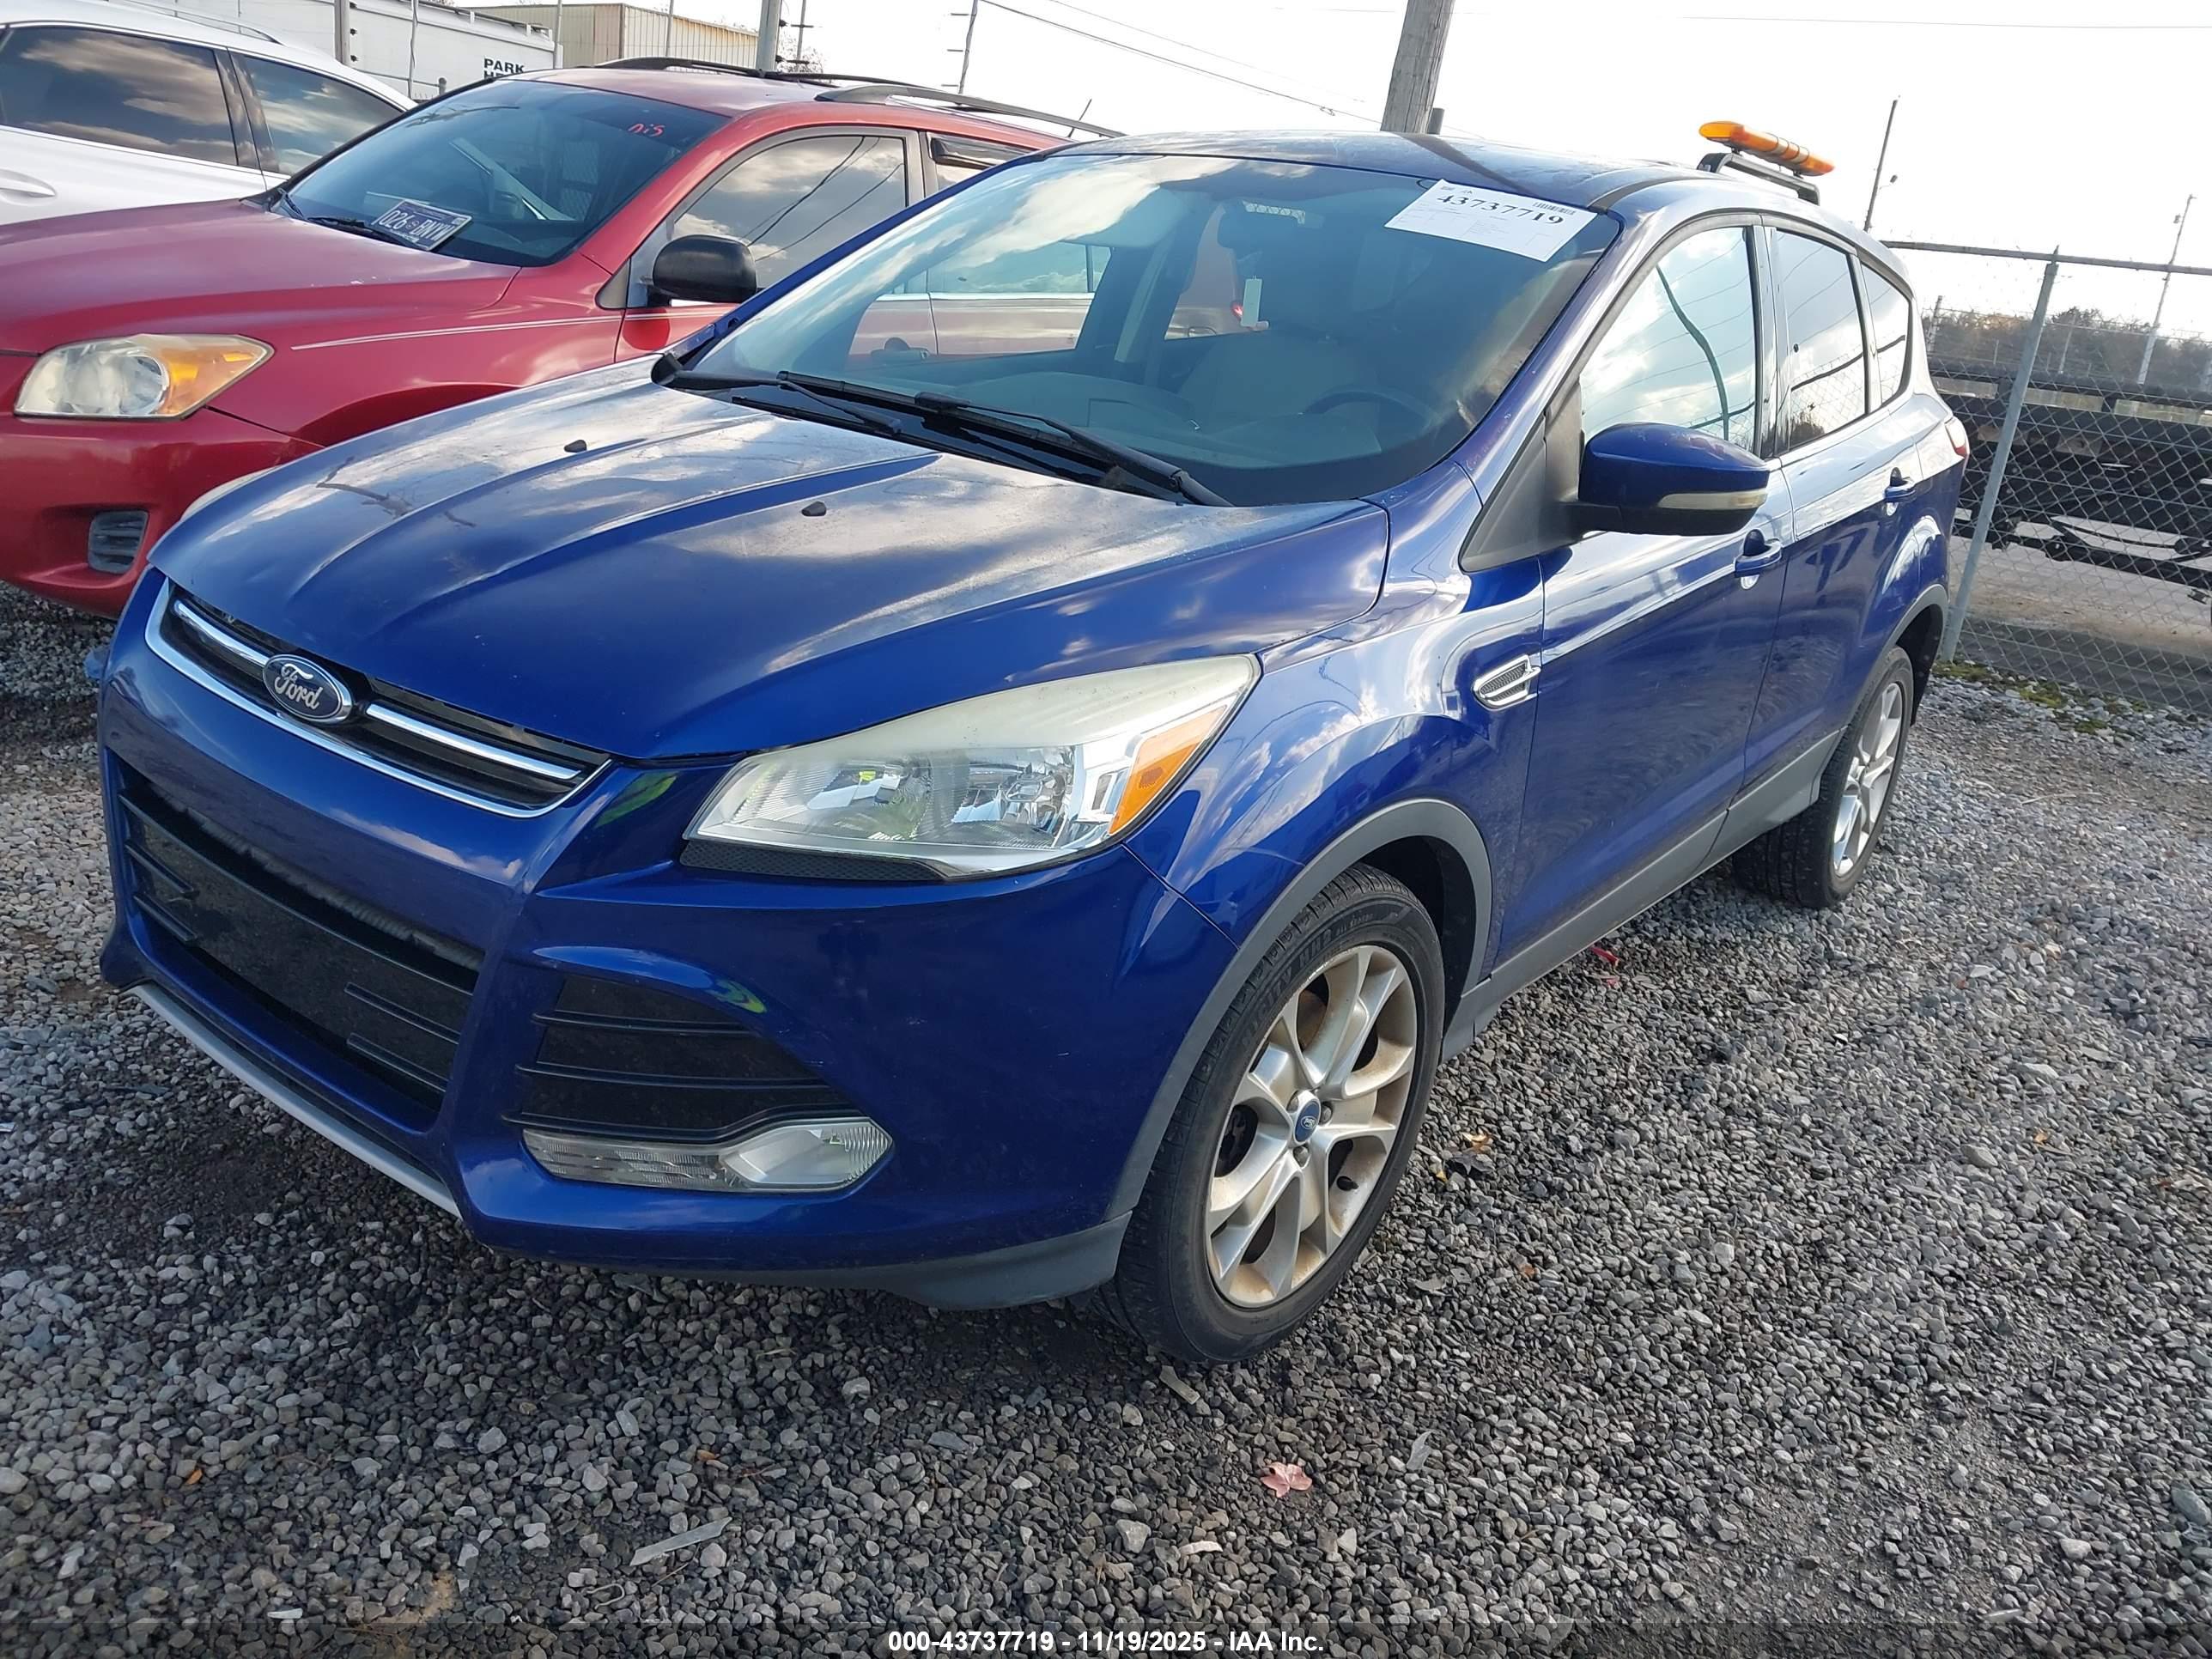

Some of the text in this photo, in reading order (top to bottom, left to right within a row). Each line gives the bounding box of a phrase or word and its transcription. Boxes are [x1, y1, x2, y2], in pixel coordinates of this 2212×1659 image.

[484, 58, 525, 75] PARK
[379, 210, 416, 230] 026
[1437, 195, 1565, 225] 43737719
[274, 663, 324, 710] Ford
